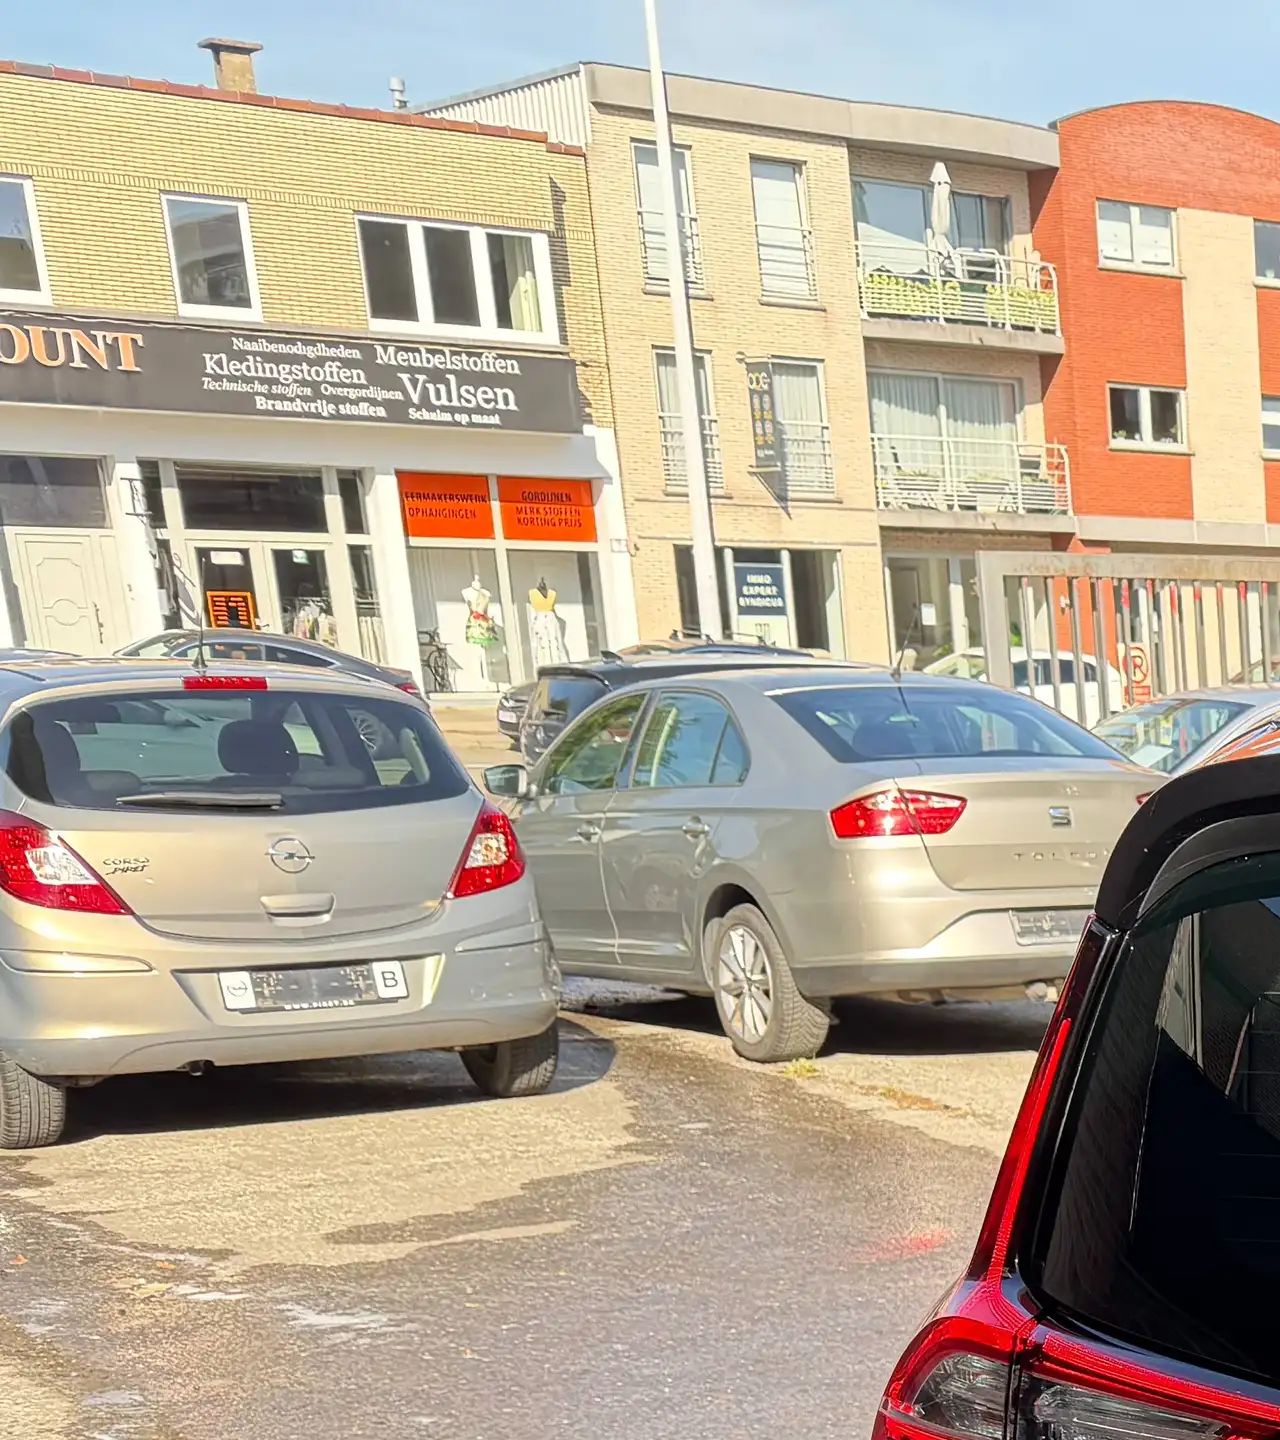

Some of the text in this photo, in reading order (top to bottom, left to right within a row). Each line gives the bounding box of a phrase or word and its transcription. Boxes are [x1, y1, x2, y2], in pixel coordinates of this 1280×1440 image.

[231, 337, 362, 359] Naaibenodigdheden
[202, 353, 368, 385] Kledingstoffen
[374, 344, 522, 375] Meubelstoffen
[202, 377, 313, 397] Technische stoffen
[320, 383, 405, 401] Overgordijnen
[397, 373, 520, 412] Vulsen
[254, 396, 387, 417] Brandvrije stoffen
[408, 407, 502, 426] Schuim op maat
[382, 971, 398, 988] B
